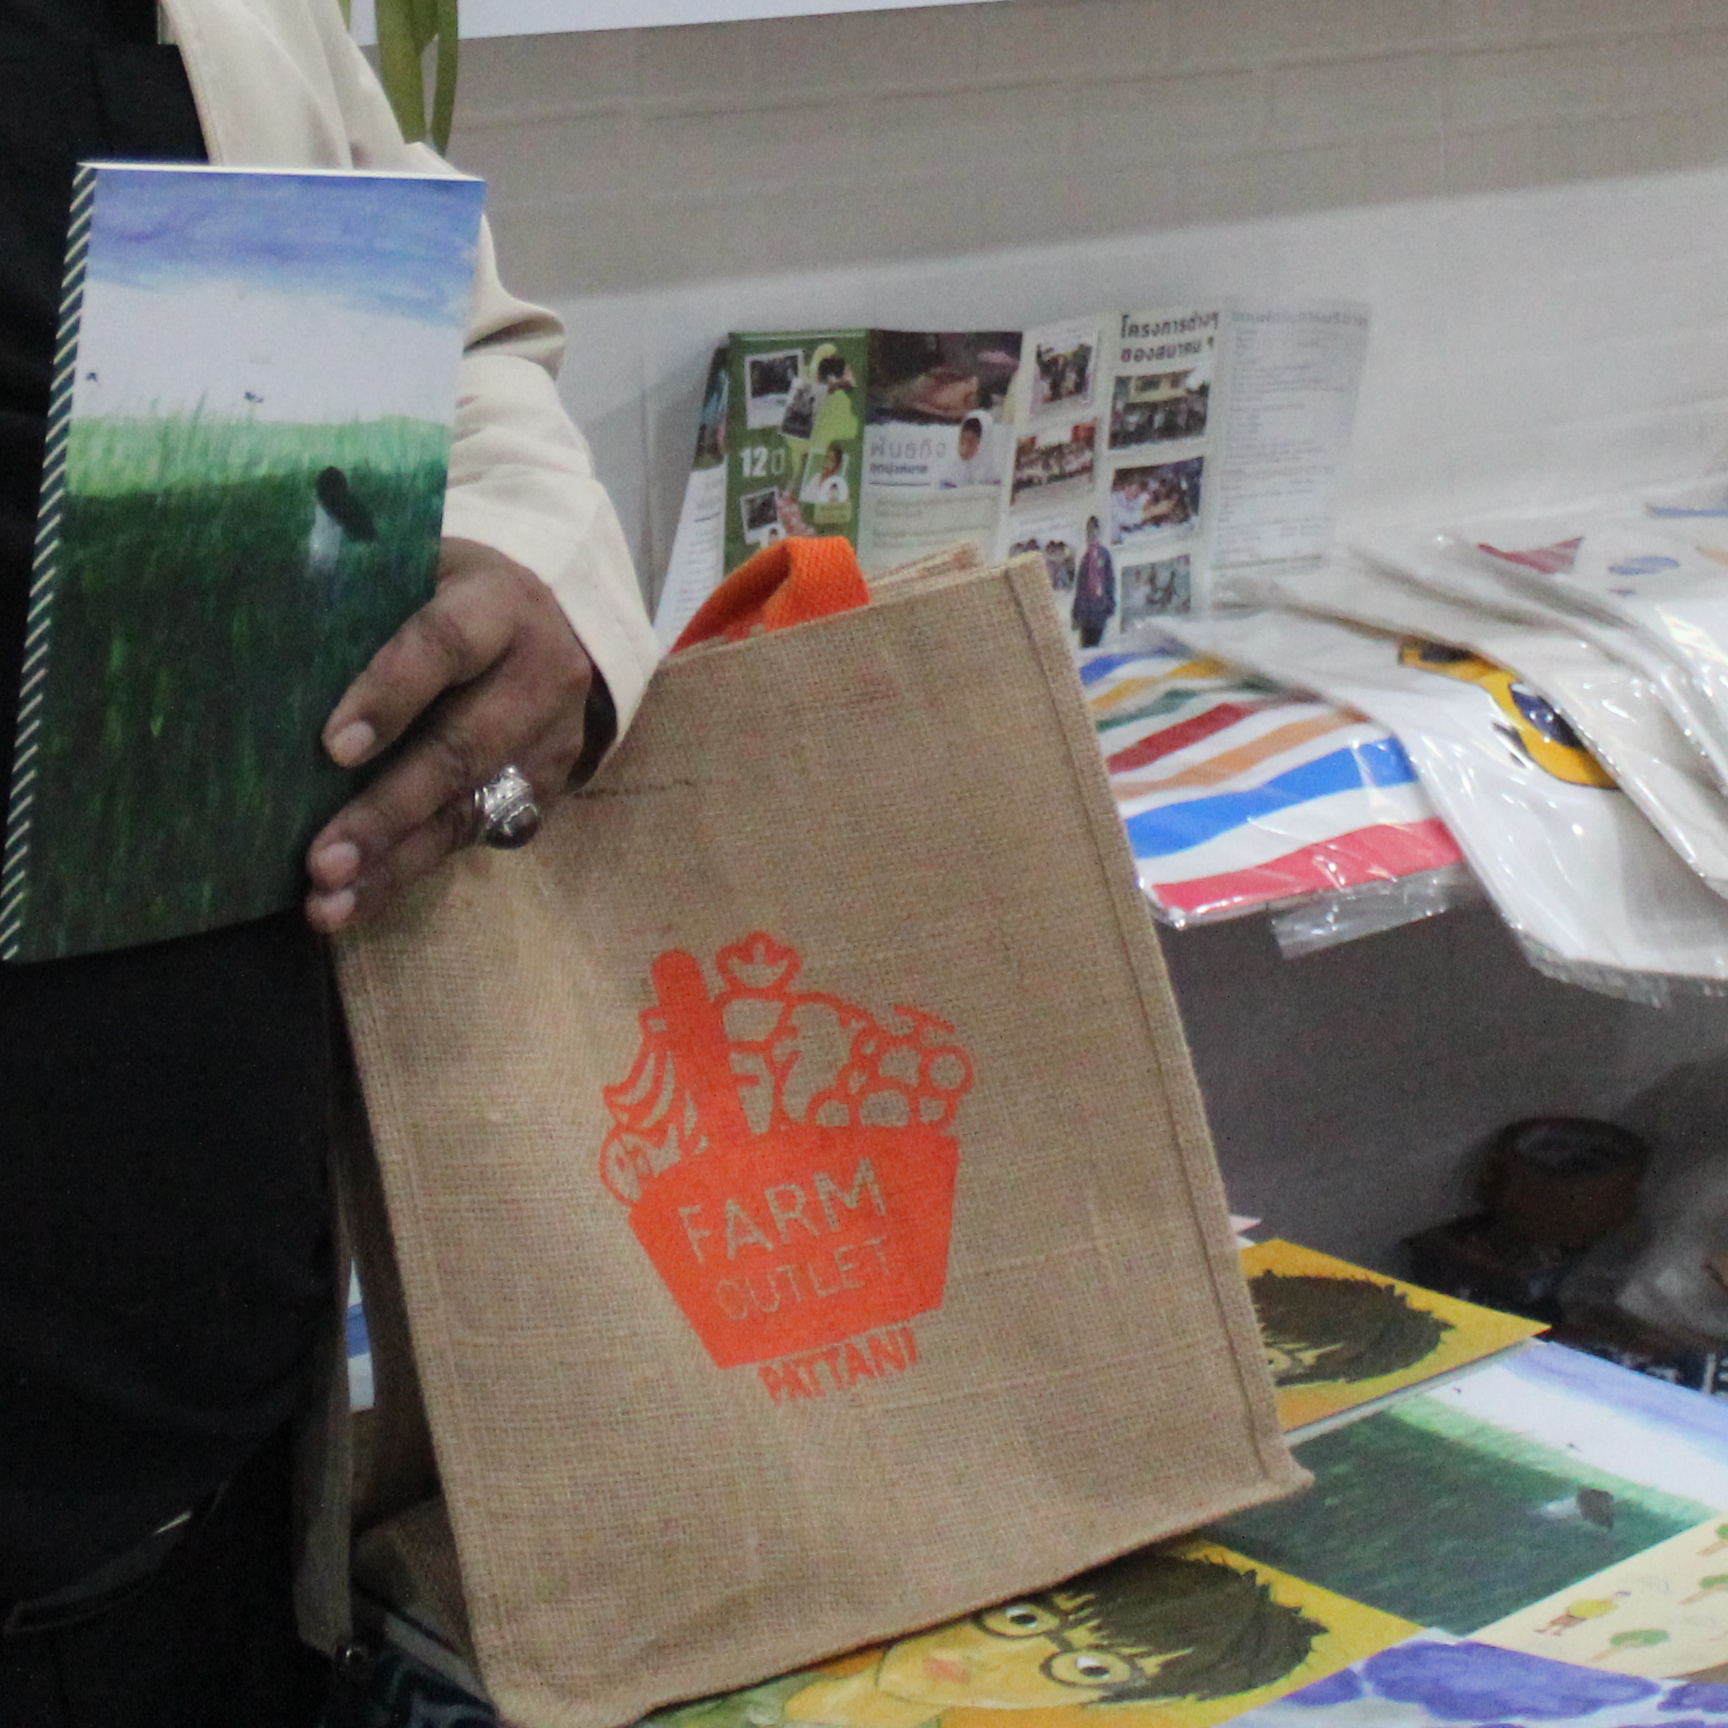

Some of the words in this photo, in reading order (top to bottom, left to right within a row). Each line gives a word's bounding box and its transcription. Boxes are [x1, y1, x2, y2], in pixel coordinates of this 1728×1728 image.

[678, 1157, 887, 1264] FARM
[716, 1236, 890, 1321] OUTLET
[757, 1325, 921, 1406] PATTANI
